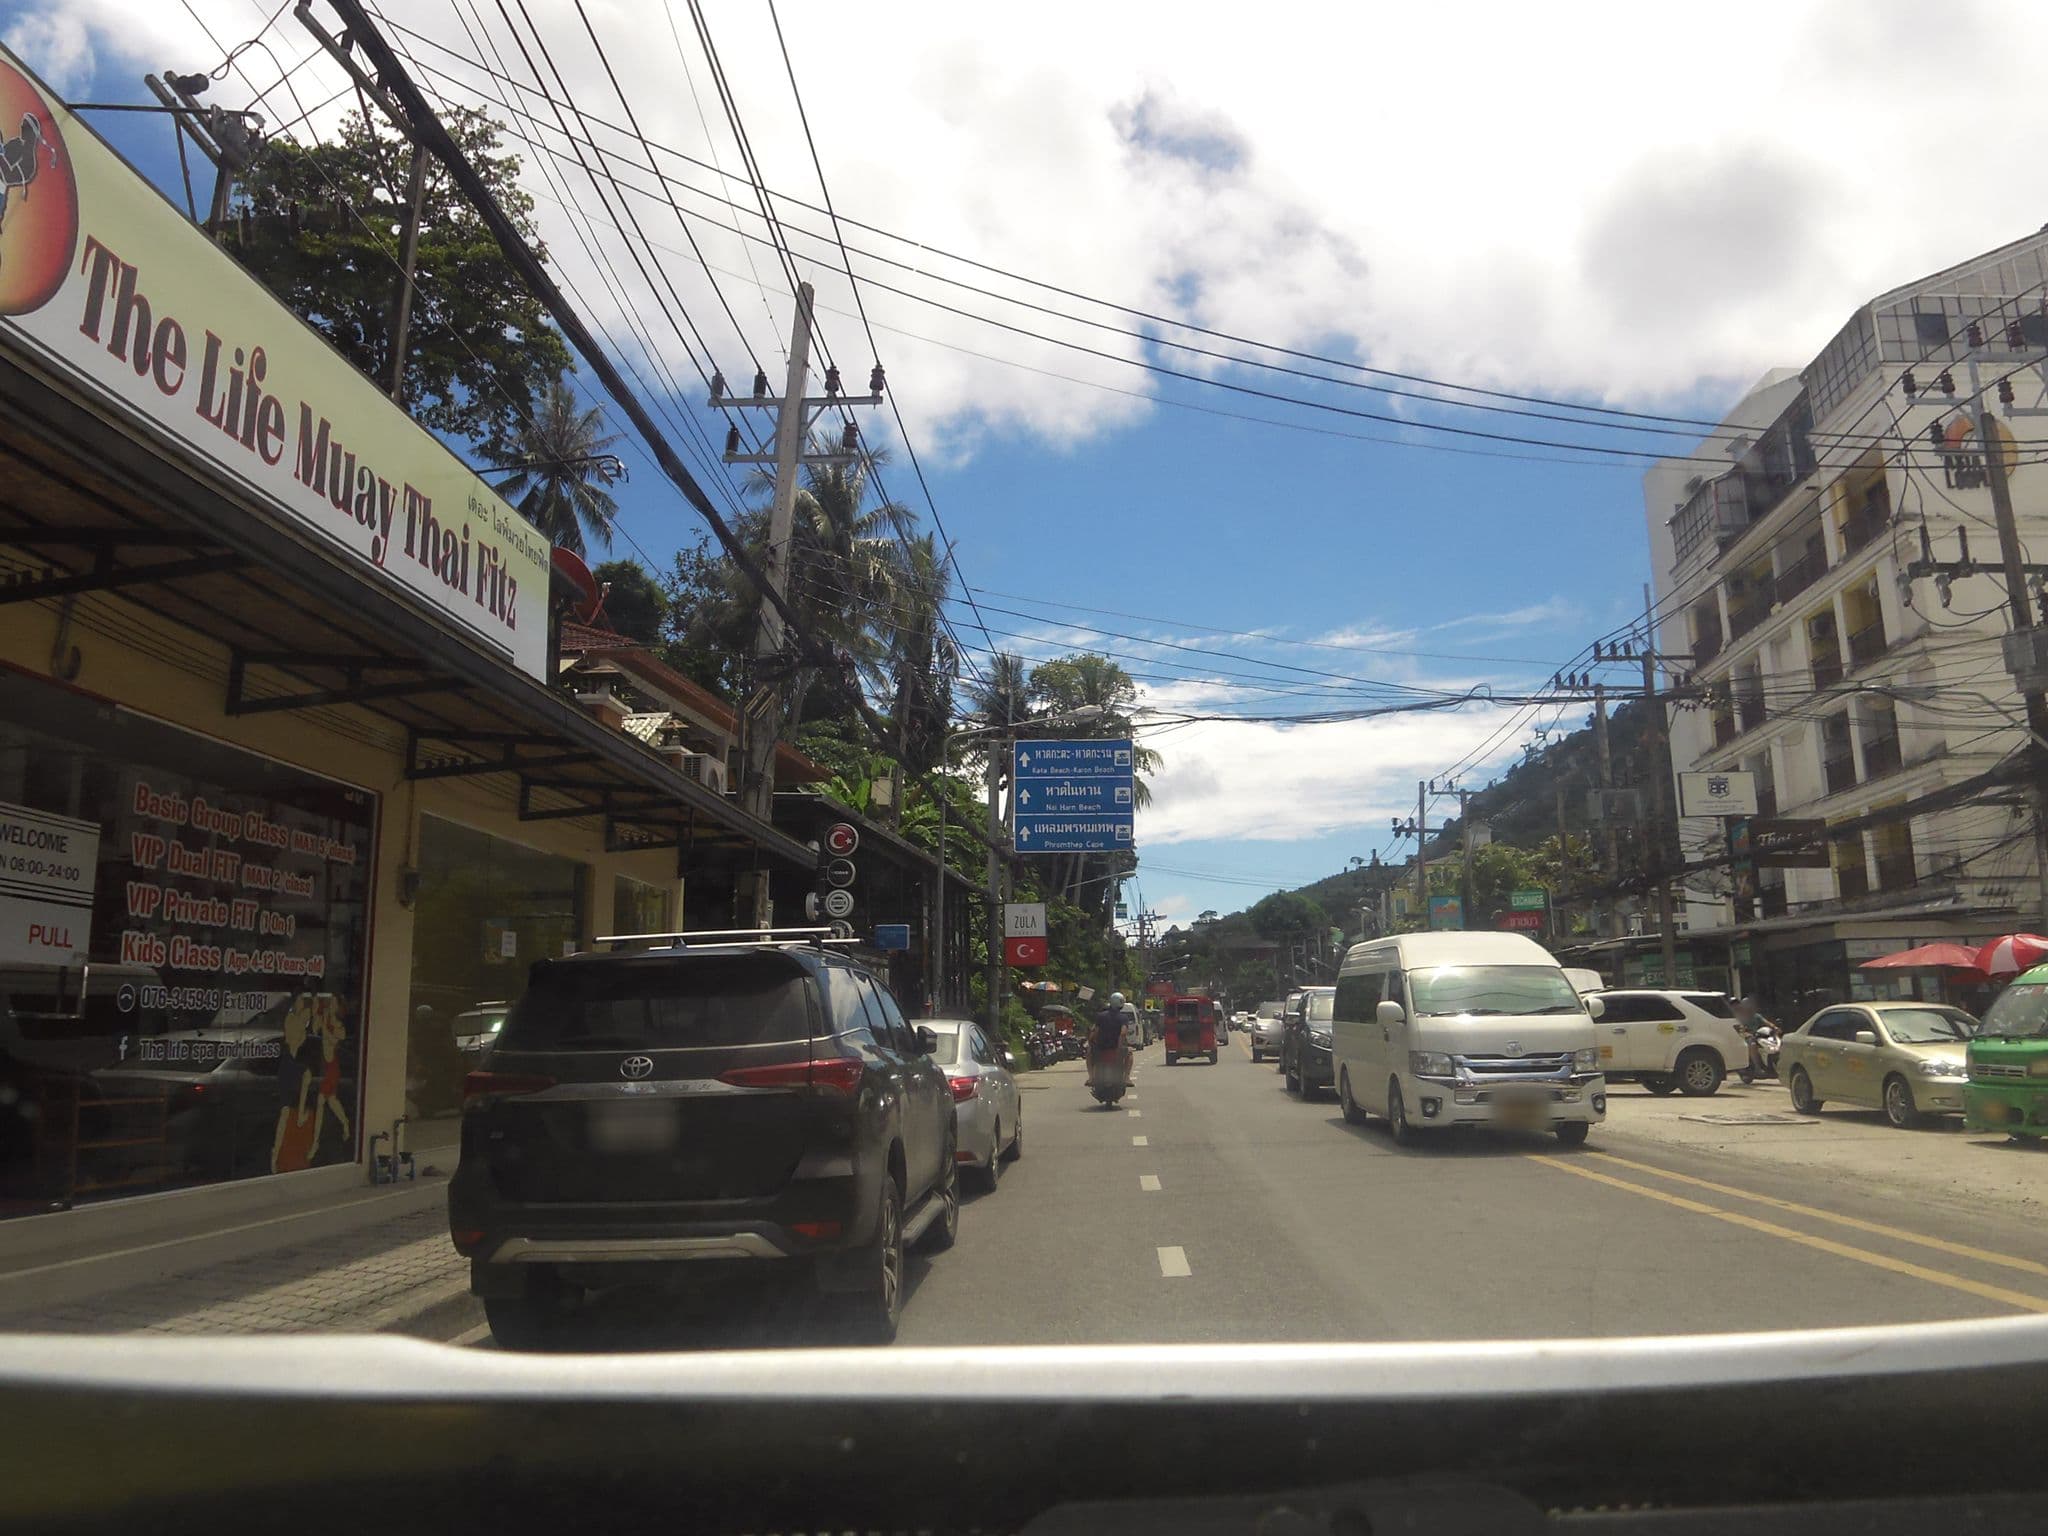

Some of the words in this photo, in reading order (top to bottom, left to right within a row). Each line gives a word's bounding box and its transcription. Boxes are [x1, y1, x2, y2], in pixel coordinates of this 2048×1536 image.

[79, 234, 187, 396] The
[196, 329, 286, 466] Life
[294, 400, 398, 569] Muay
[403, 482, 471, 597] Thai
[475, 540, 518, 632] Fitz
[1094, 766, 1115, 774] Beach
[134, 782, 188, 824] Basic
[191, 797, 241, 841] Group
[244, 812, 289, 847] Class
[10, 857, 80, 881] 08:00-24:00
[132, 832, 165, 869] VIP
[168, 840, 209, 879] Dual
[211, 849, 240, 883] FIT
[242, 864, 272, 889] (MAX
[127, 881, 160, 917] VIP
[163, 889, 228, 927] Private
[231, 898, 259, 931] FIT
[1014, 915, 1037, 929] ZULA
[29, 923, 73, 948] PULL
[121, 930, 165, 968] Kids
[170, 935, 220, 971] Class
[224, 948, 249, 975] (Age
[250, 950, 274, 973] 4-12
[275, 952, 306, 974] Years
[140, 985, 220, 1011] 076-345949
[140, 1039, 166, 1061] The
[167, 1039, 188, 1060] life
[193, 1042, 214, 1063] spa
[218, 1040, 239, 1059] and
[241, 1039, 281, 1059] fitness
